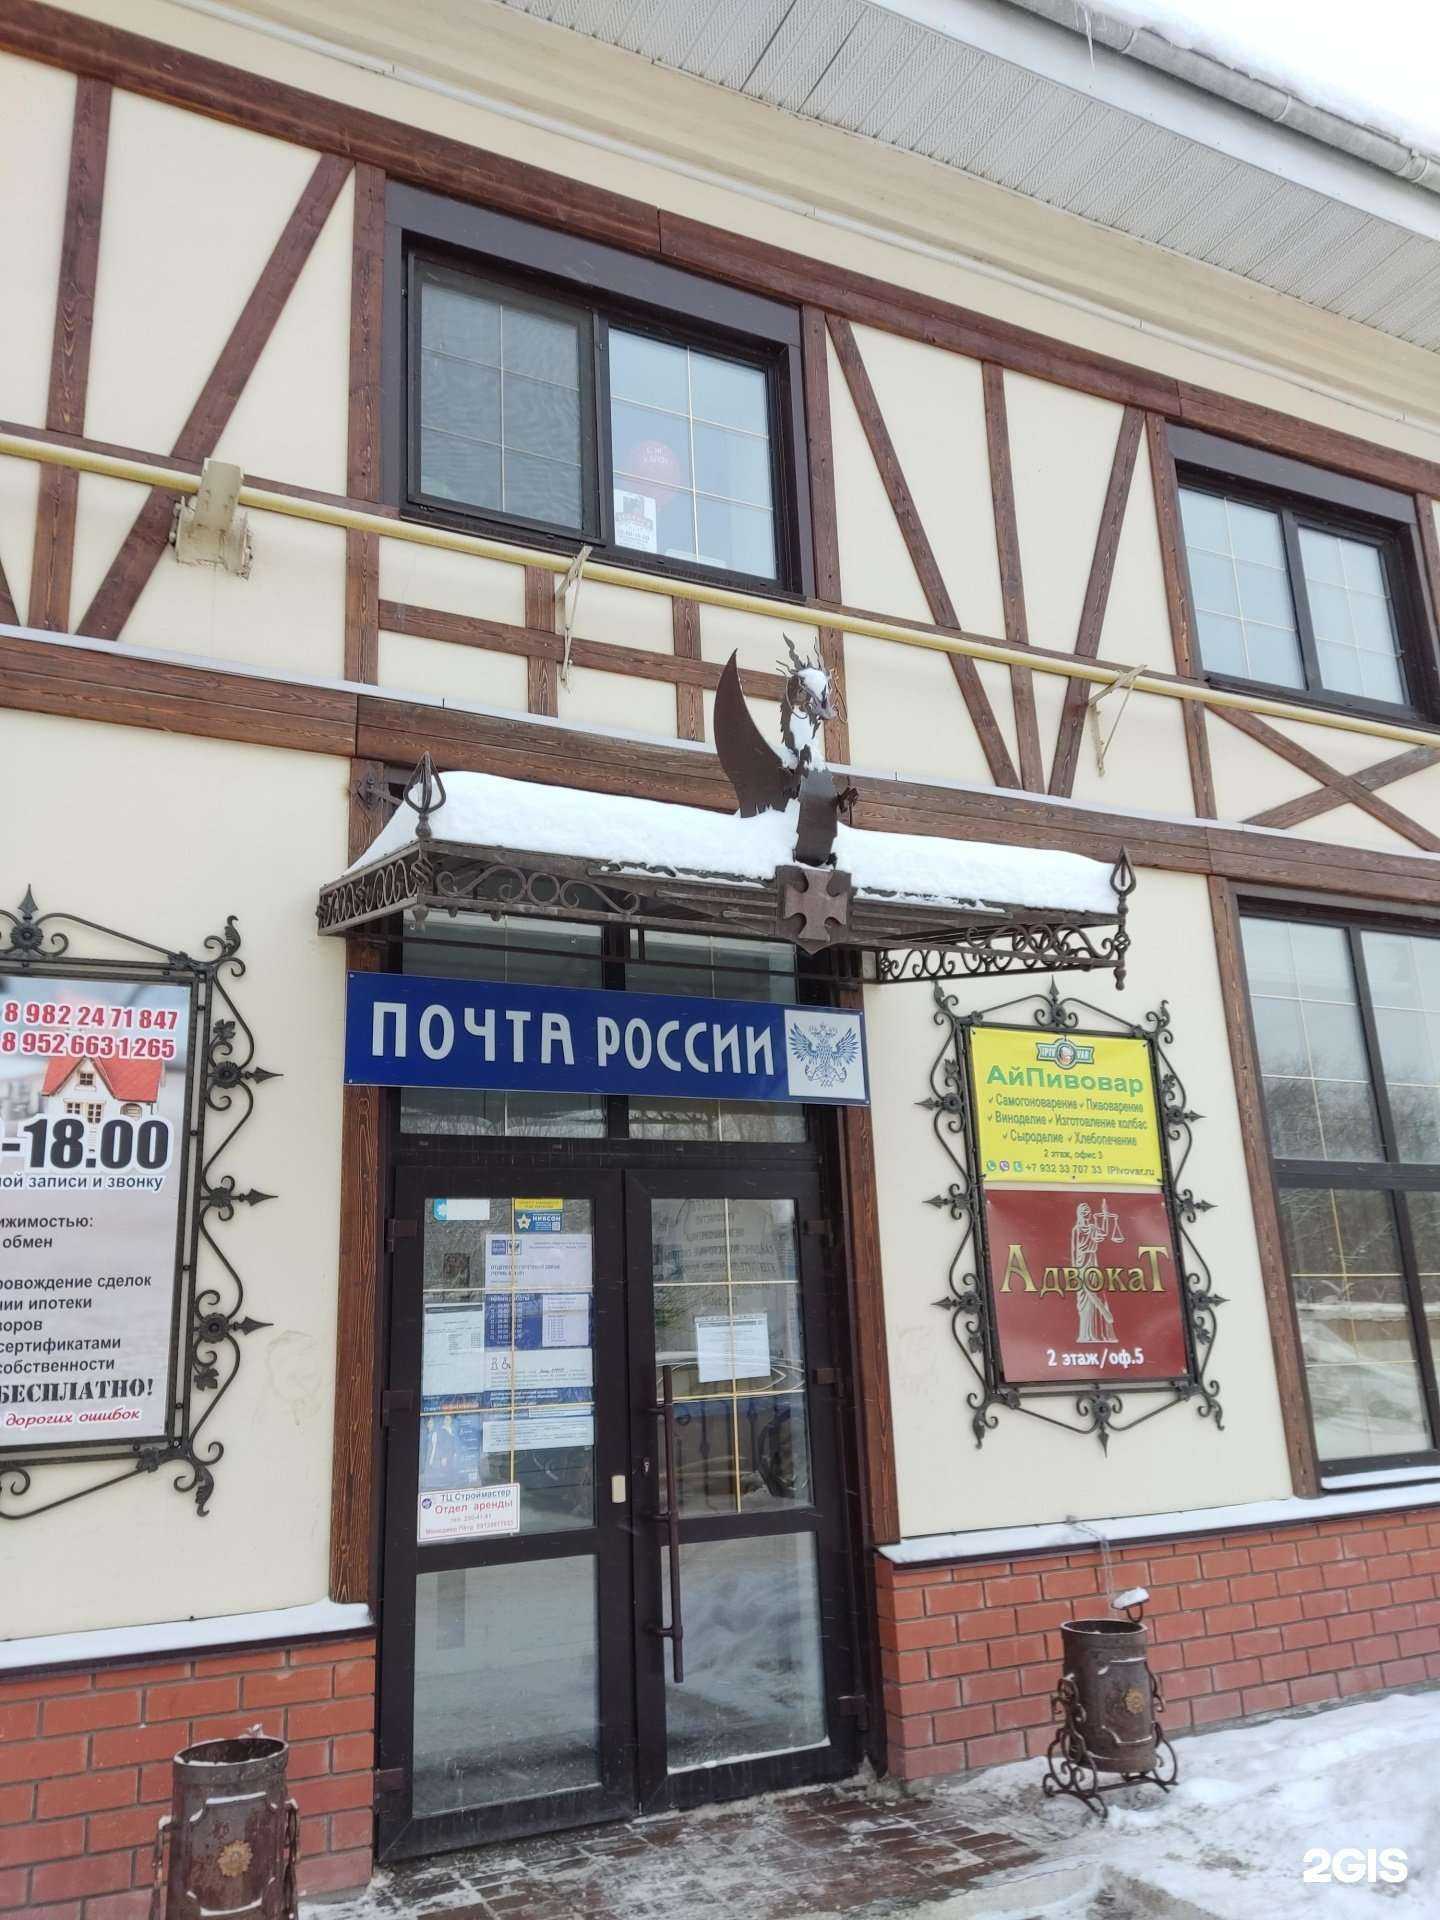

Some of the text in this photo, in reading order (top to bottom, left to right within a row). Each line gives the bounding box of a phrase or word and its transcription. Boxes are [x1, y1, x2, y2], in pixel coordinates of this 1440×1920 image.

[4, 1002, 178, 1030] 8 982 24 71 847
[2, 1032, 16, 1052] 8
[22, 1033, 66, 1054] 952
[371, 1001, 776, 1076] ПОЧТА РОССИИ
[986, 1065, 1144, 1097] АйПивовар
[995, 1093, 1144, 1114] Самогоноварение Пивоварение
[995, 1111, 1047, 1126] Виноделие
[1055, 1114, 1116, 1128] Изготовление
[1010, 1129, 1137, 1146] Сыроделие Хлебопечение
[0, 1171, 164, 1192] ой записи и звонку
[3, 1234, 53, 1248] обмен
[0, 1275, 152, 1291] овождение сделок
[0, 1297, 92, 1311] ии ипотеки
[0, 1319, 43, 1336] оров
[1046, 1349, 1057, 1366] 2
[6, 1407, 140, 1429] дорогих ошибок
[435, 1499, 513, 1514] Отдел аренды
